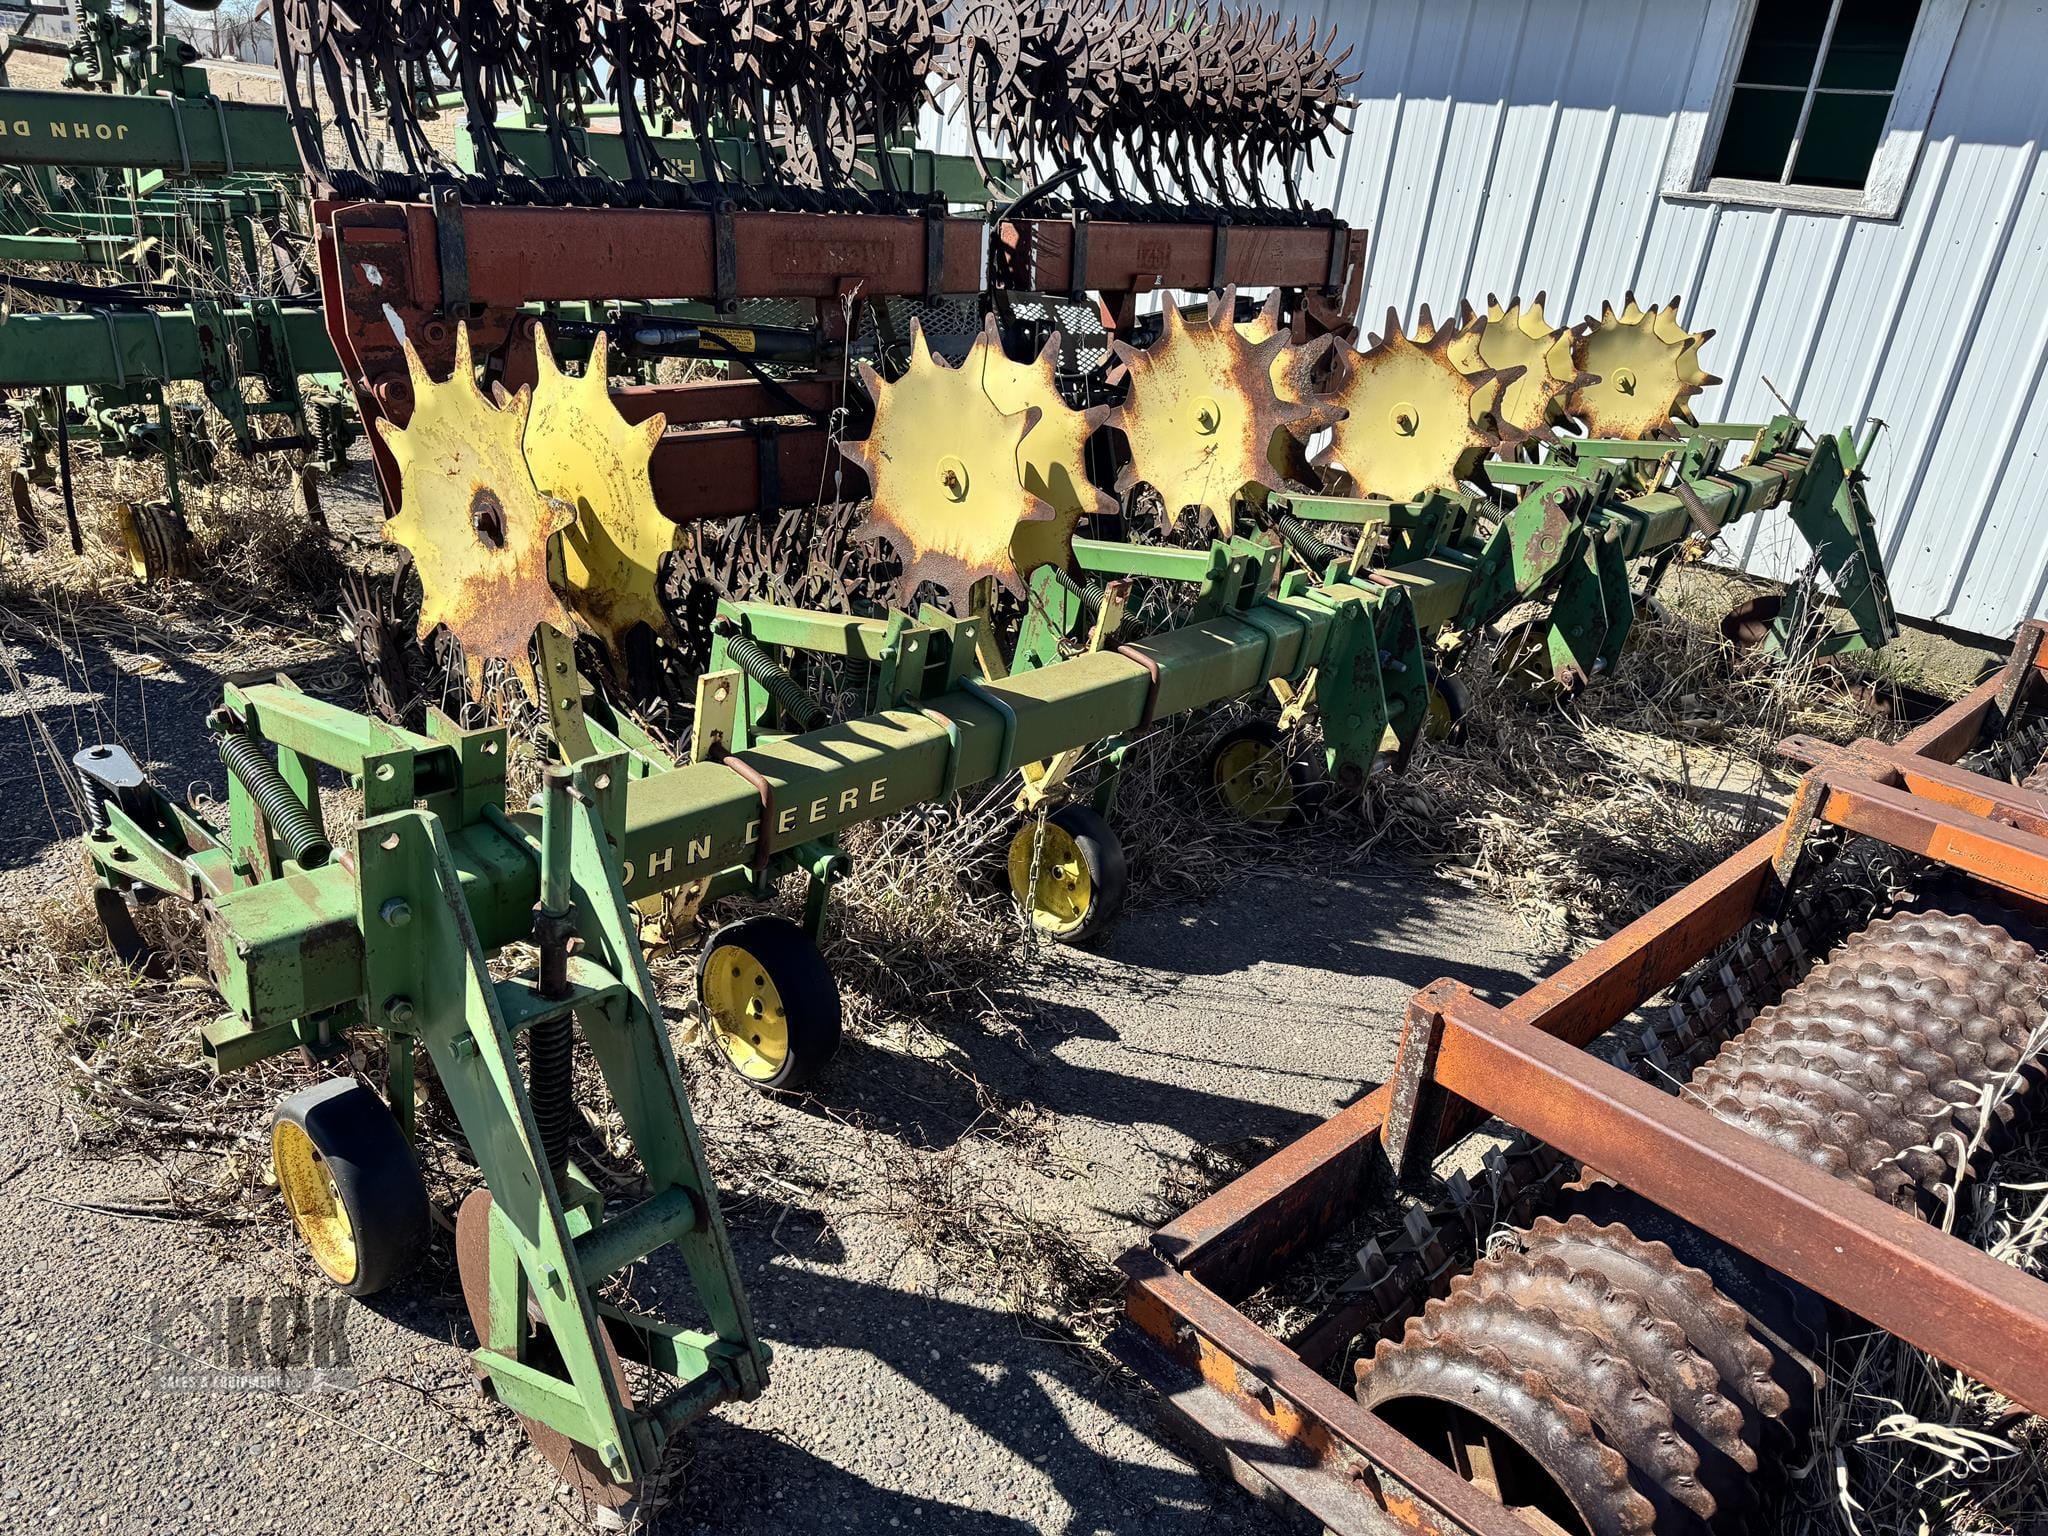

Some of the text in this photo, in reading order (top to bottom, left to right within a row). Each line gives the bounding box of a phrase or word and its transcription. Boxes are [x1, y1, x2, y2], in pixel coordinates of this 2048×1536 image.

[50, 122, 129, 140] JOHN
[622, 777, 888, 887] HN DEERE
